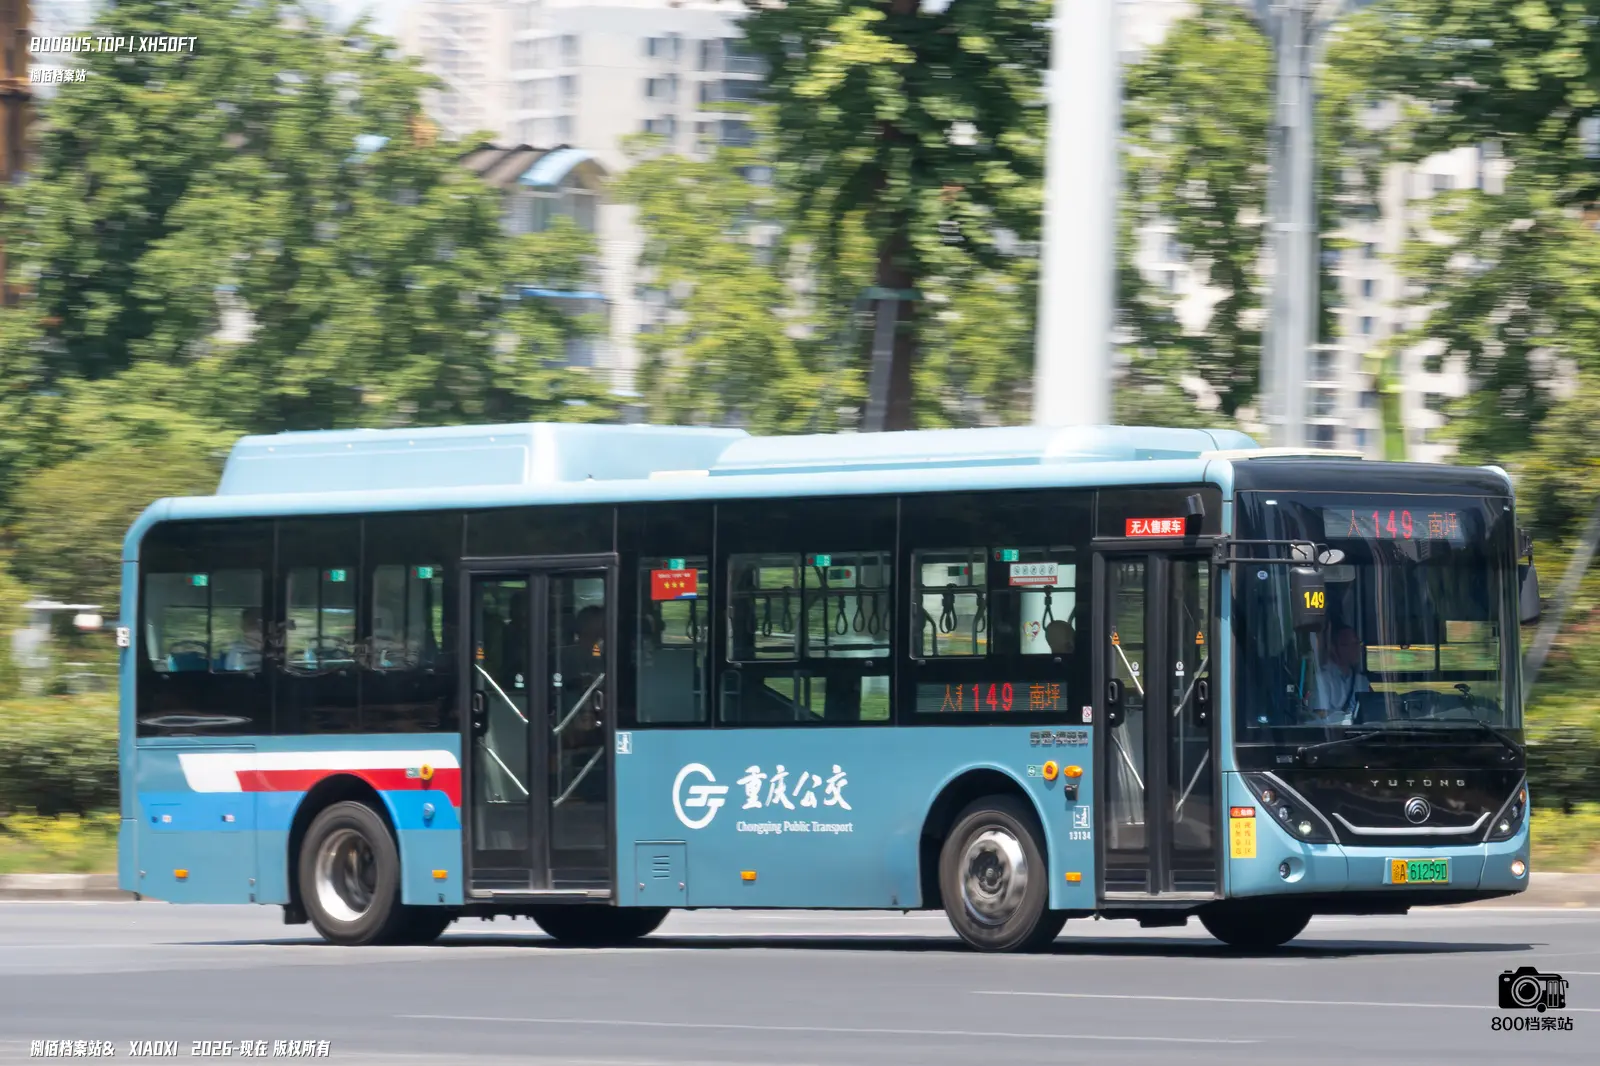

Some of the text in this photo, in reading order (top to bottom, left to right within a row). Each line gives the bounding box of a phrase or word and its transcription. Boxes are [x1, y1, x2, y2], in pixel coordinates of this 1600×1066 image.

[1131, 520, 1182, 534] 无人售票车
[1372, 510, 1413, 539] 149
[1428, 512, 1458, 539] 南坪
[1303, 591, 1325, 609] 149
[971, 683, 1013, 712] 149
[1029, 683, 1061, 711] 南坪
[736, 764, 852, 810] 重庆公交
[1371, 779, 1465, 787] YUTONG
[736, 821, 853, 834] Chongqing Public Transport
[1069, 831, 1091, 840] 13134
